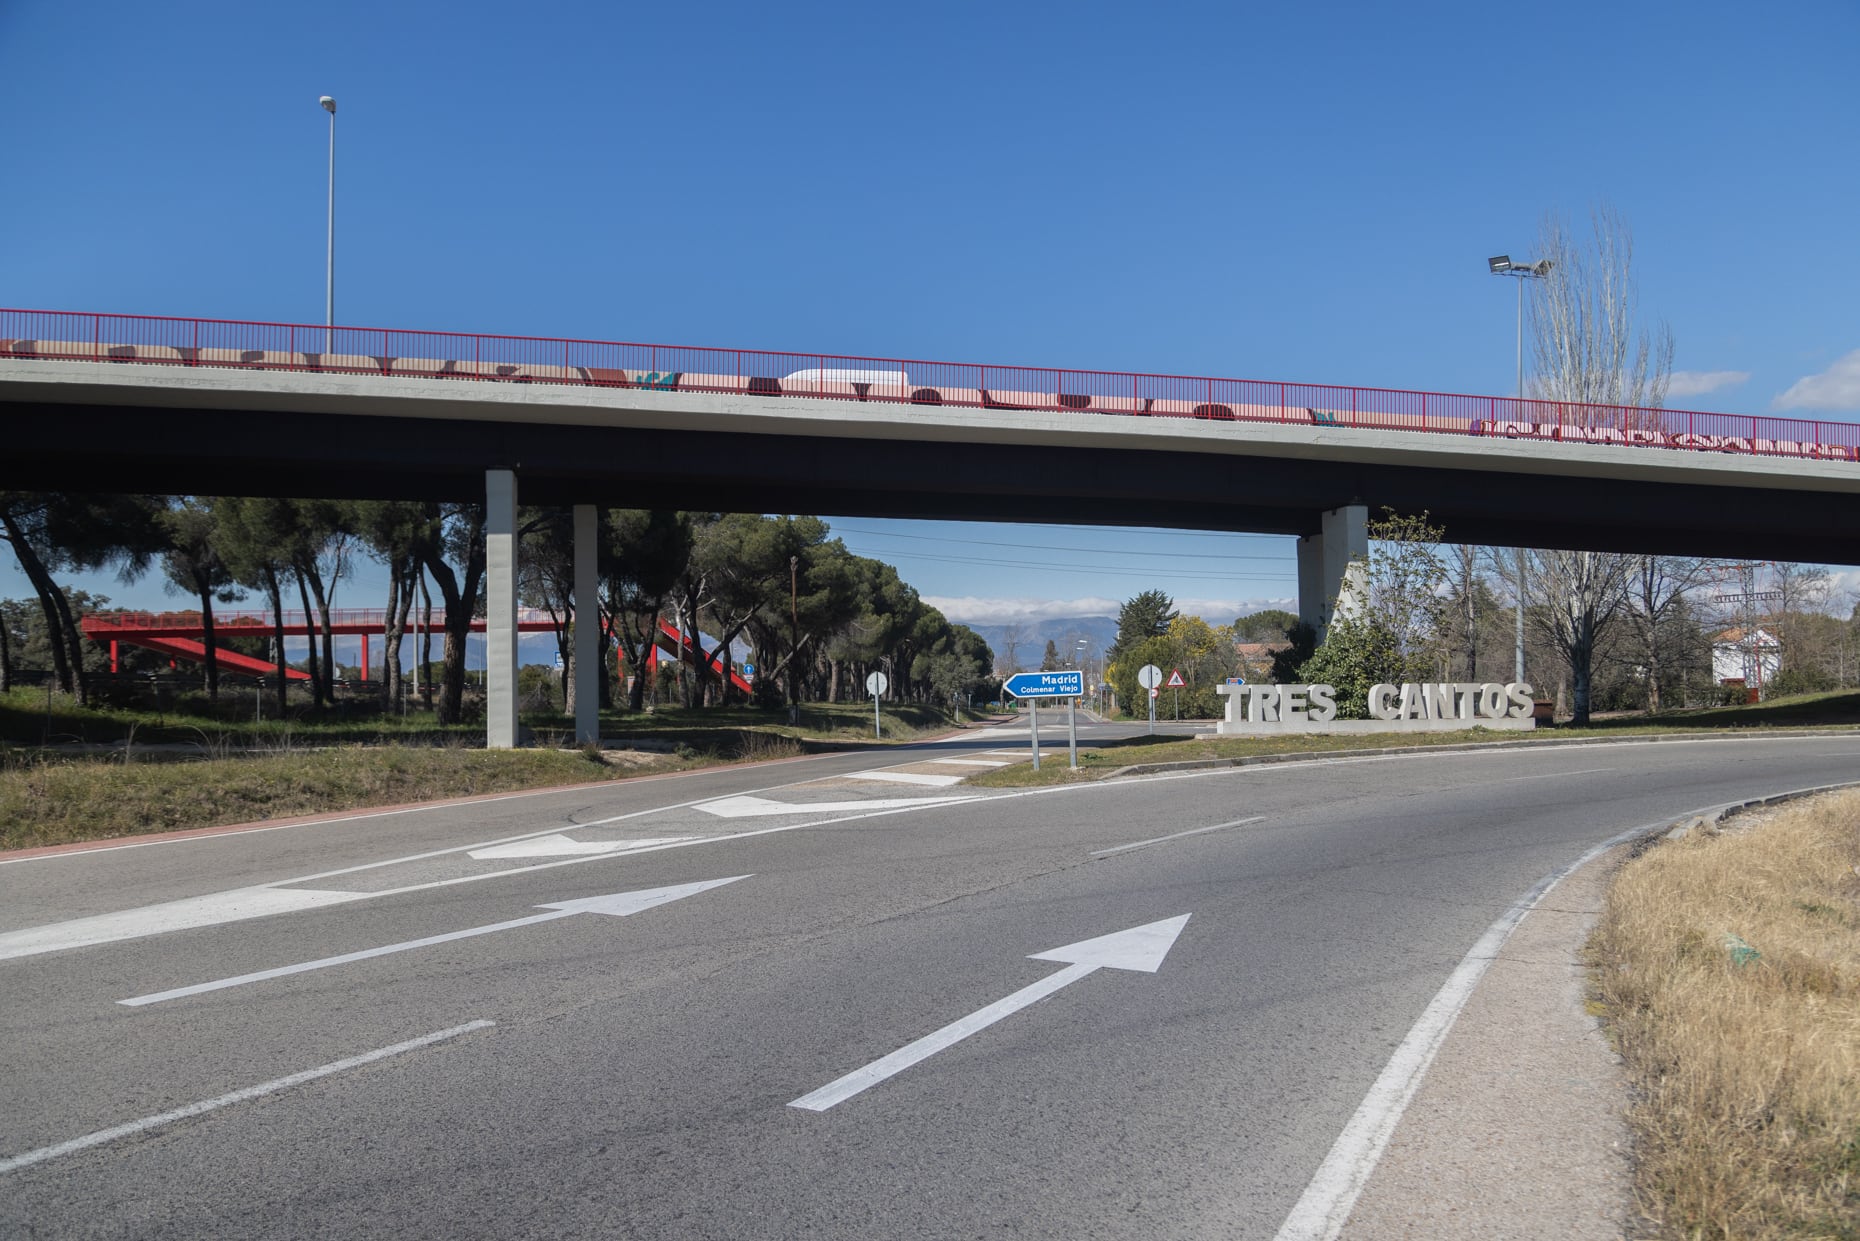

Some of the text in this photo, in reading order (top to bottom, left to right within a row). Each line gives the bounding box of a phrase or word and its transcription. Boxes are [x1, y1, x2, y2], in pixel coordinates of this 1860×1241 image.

[1042, 675, 1078, 685] Madrid
[1020, 685, 1078, 694] Colmenar Viejo
[1216, 682, 1534, 722] TRES CANTOS
